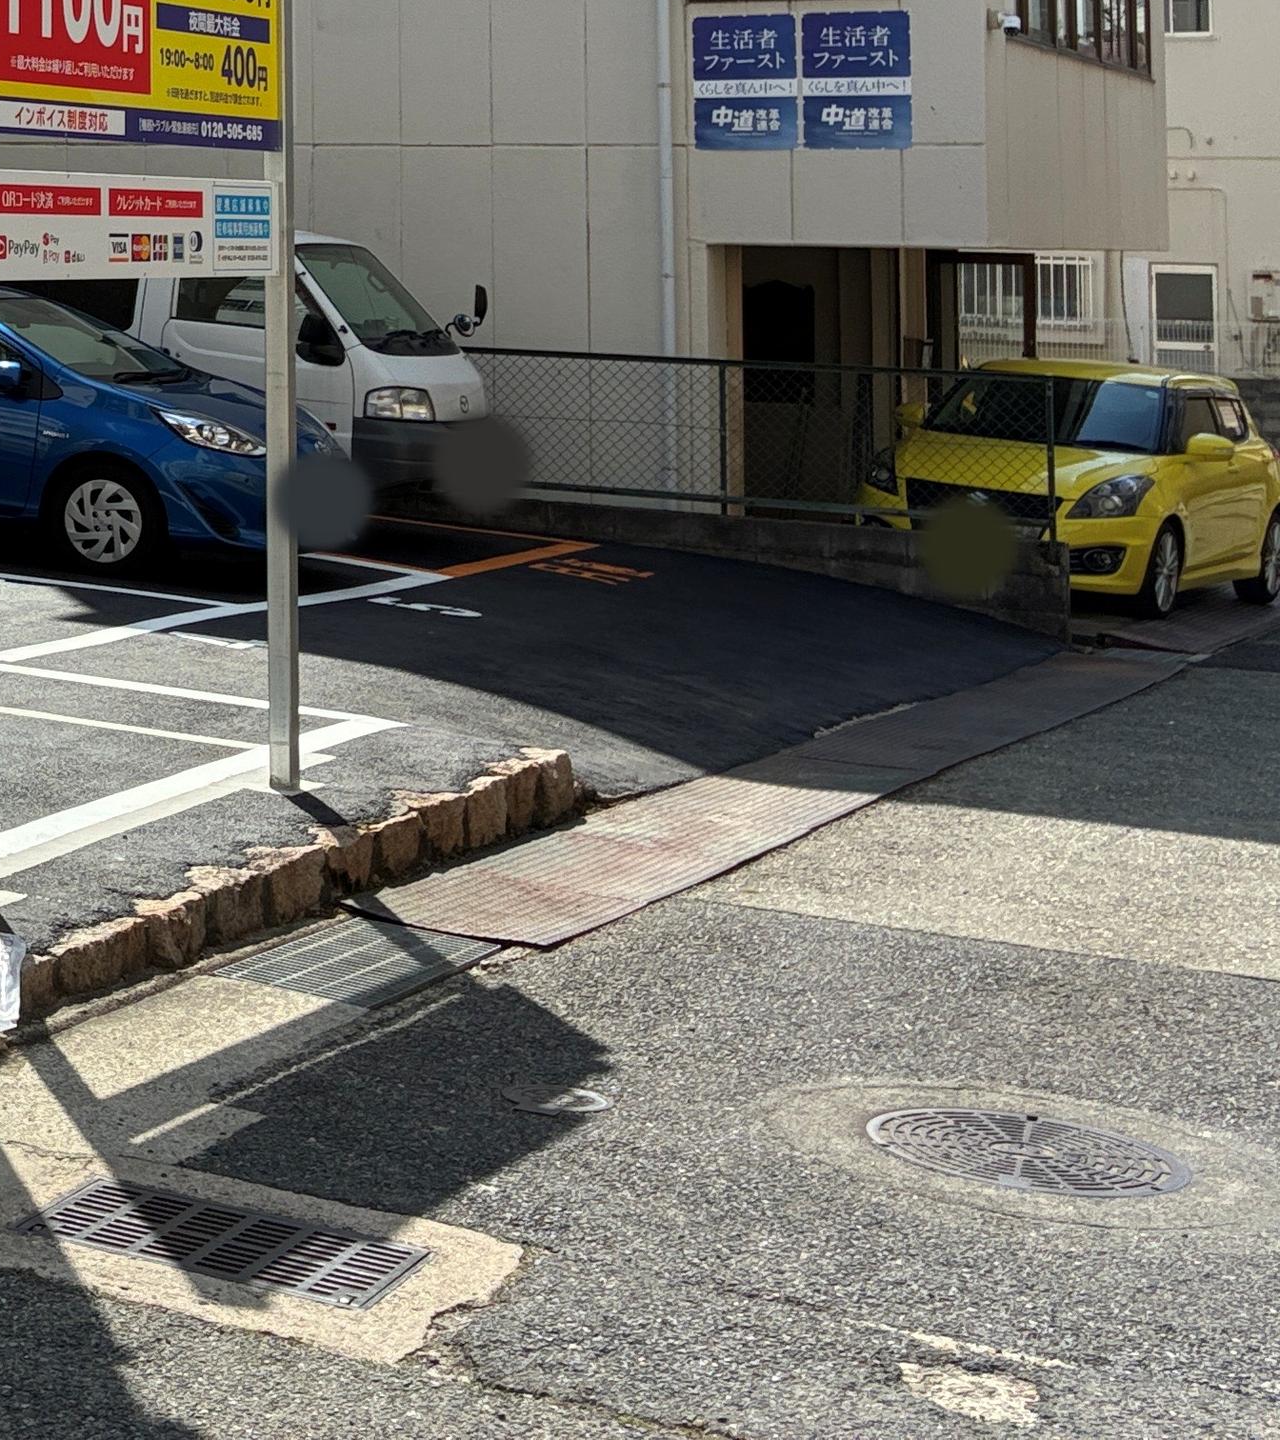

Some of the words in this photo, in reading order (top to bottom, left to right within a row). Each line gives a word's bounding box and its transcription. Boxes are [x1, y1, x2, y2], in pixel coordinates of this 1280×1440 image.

[188, 11, 241, 37] 夜間最大料金
[709, 28, 778, 50] 生活者
[820, 25, 891, 47] 生活者
[221, 44, 268, 92] 400円
[703, 51, 786, 72] ファースト
[813, 48, 899, 69] ファースト
[15, 106, 109, 132] インボイス制度対応
[1, 190, 54, 209] QRコード決済
[116, 194, 162, 211] クレジットカード
[8, 240, 40, 258] PayPay
[111, 242, 128, 254] VISA
